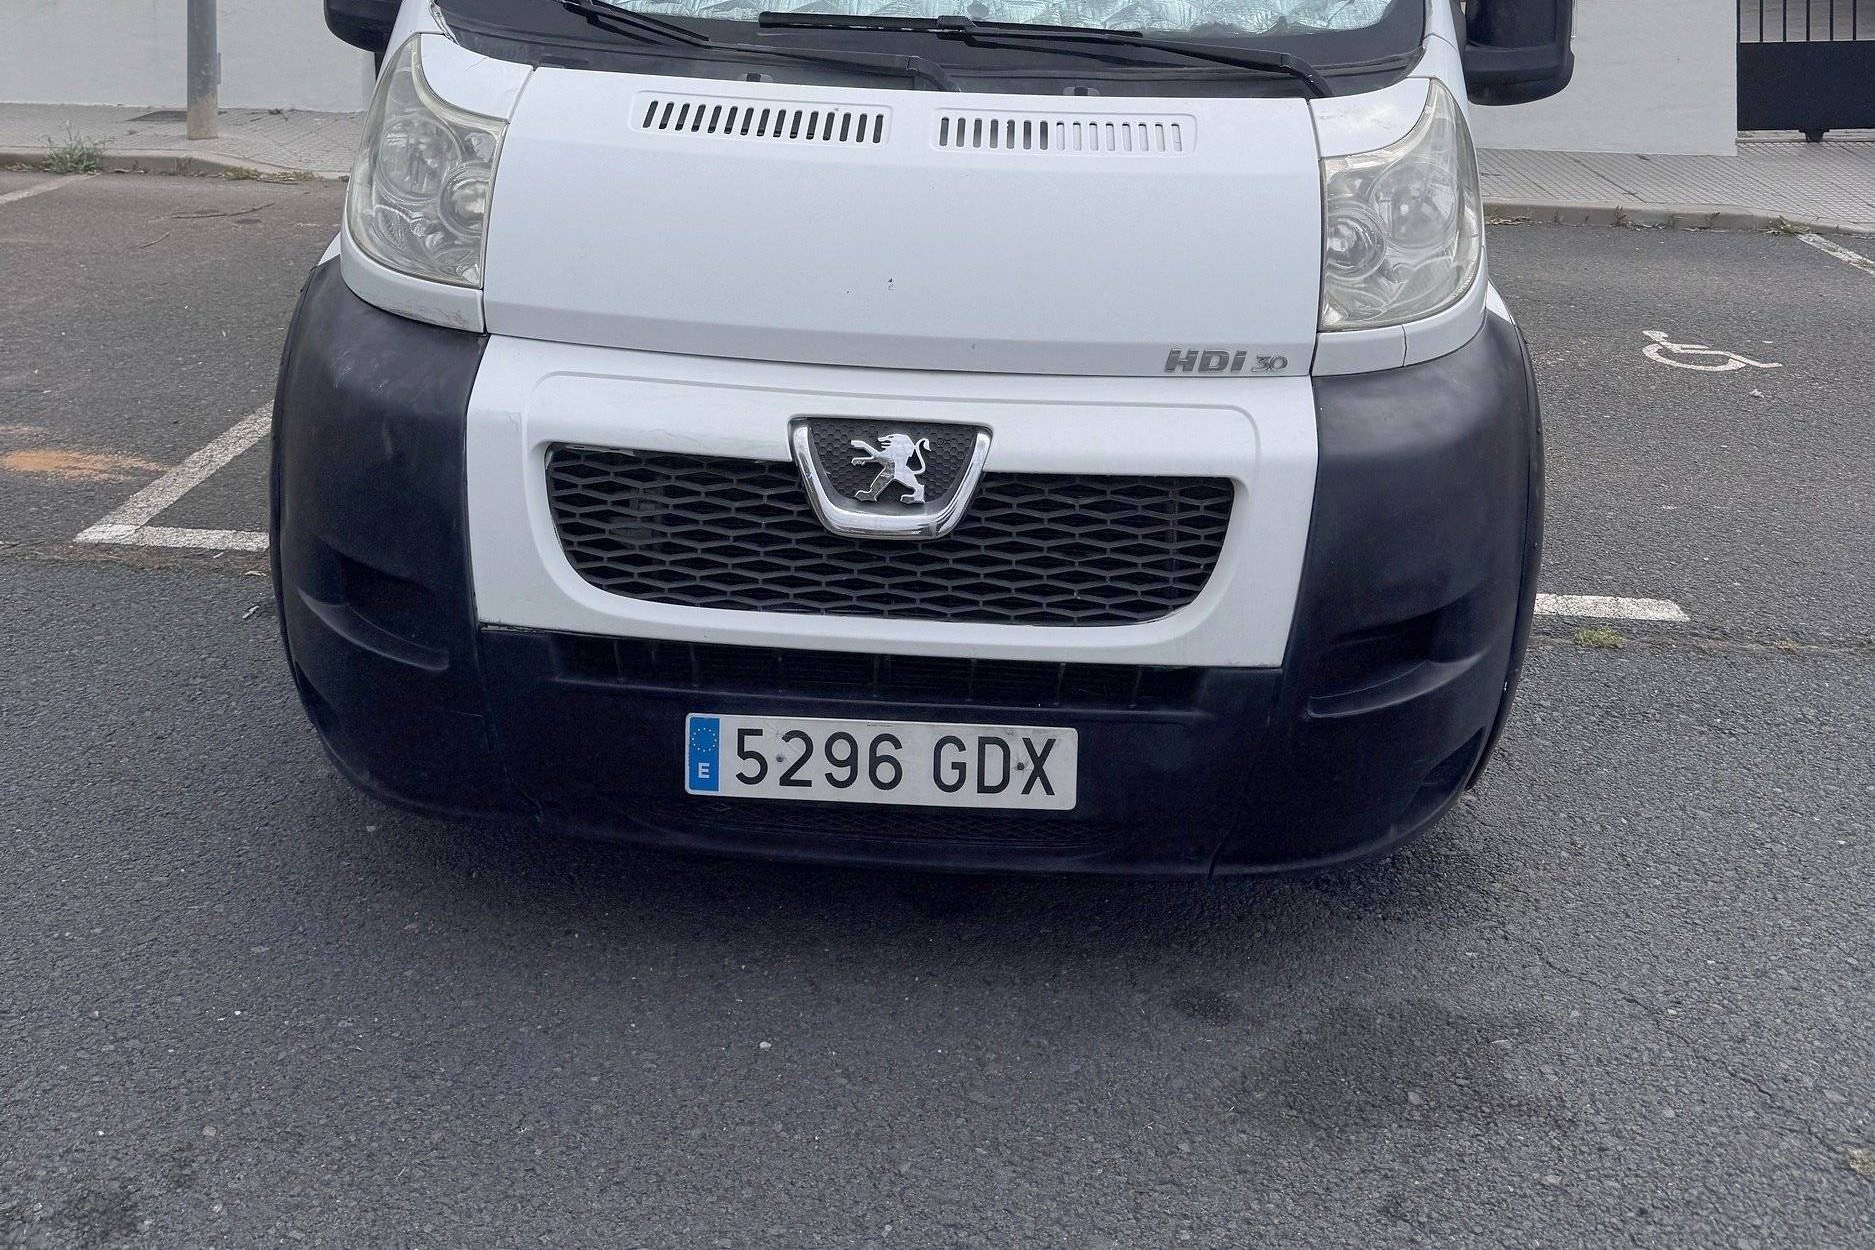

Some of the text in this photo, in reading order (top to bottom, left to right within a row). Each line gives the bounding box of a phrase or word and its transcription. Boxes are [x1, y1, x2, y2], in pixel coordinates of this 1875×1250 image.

[1164, 349, 1248, 373] HDi
[698, 762, 710, 779] E
[734, 727, 1057, 796] 5296 GDX
